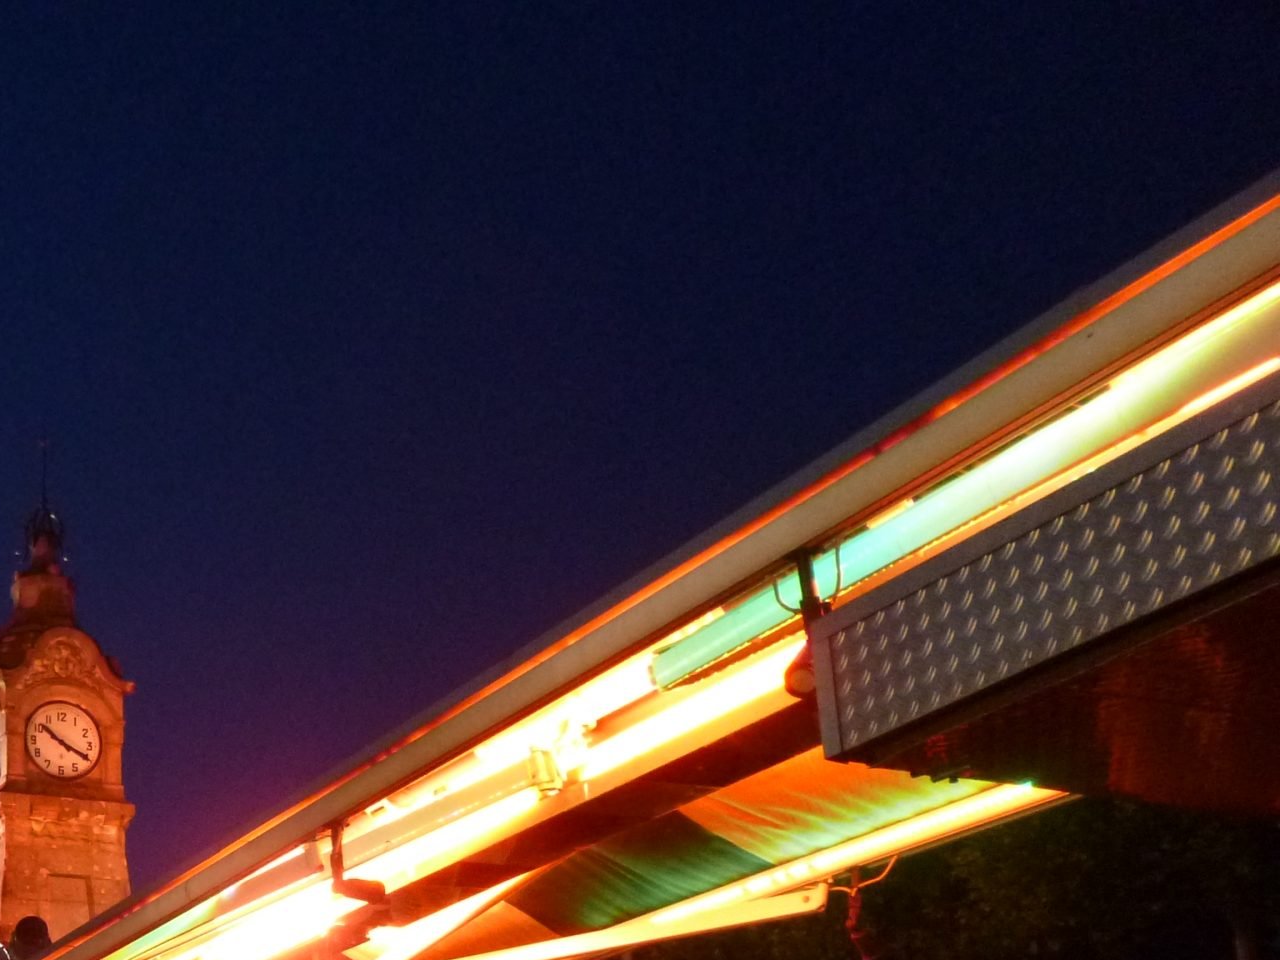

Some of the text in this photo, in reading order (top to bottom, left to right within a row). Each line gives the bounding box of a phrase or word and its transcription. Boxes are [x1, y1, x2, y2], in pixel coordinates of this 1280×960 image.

[45, 715, 52, 724] 11
[57, 712, 67, 722] 12
[73, 717, 77, 726] 1
[34, 723, 44, 733] 10
[82, 728, 88, 738] 2
[30, 735, 36, 745] 9
[87, 742, 93, 751] 3
[35, 748, 41, 757] 8
[45, 760, 51, 769] 7
[72, 763, 78, 772] 5
[58, 766, 64, 775] 6
